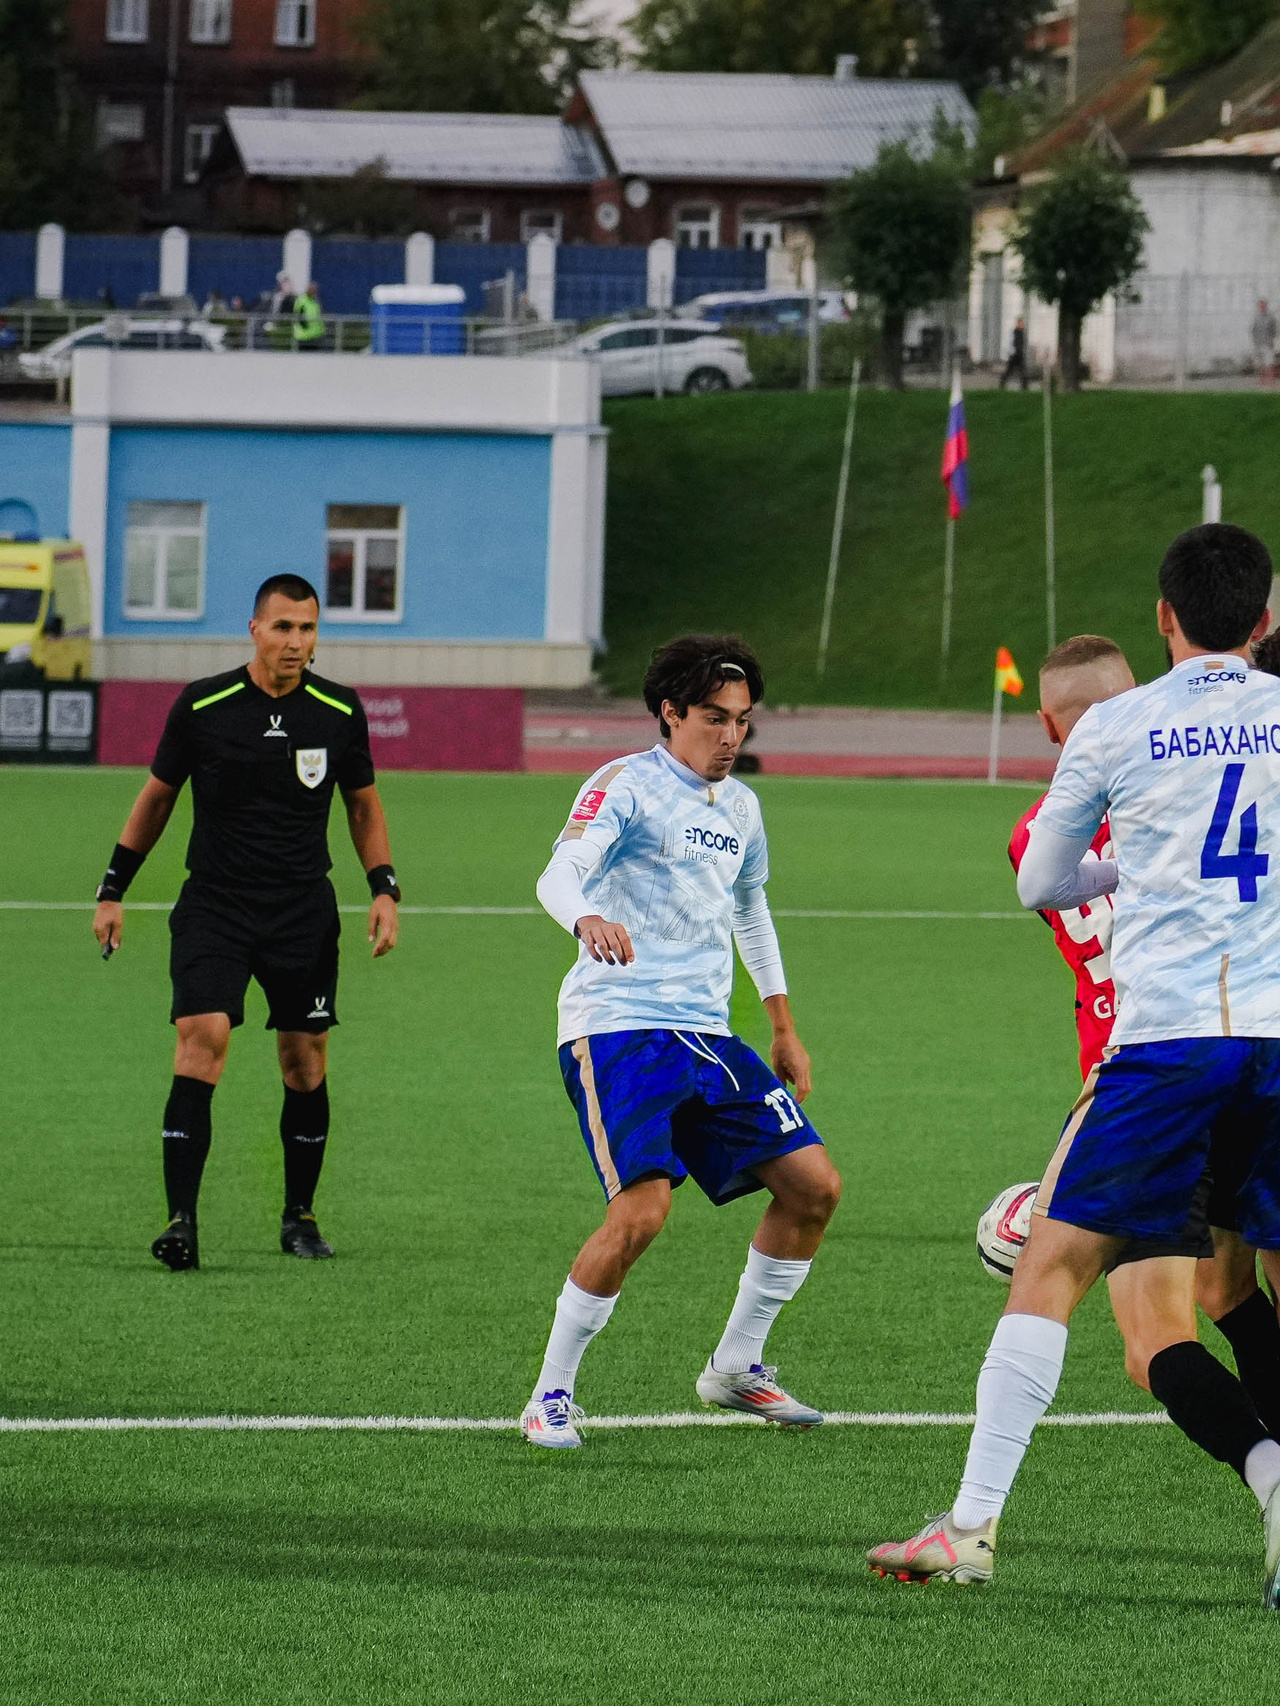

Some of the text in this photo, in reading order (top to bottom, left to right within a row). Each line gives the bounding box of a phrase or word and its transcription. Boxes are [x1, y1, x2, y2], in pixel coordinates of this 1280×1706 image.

[1187, 671, 1247, 686] encore
[1188, 684, 1224, 696] fitness
[685, 826, 739, 856] encore
[1200, 763, 1270, 903] 4
[684, 845, 719, 865] fitness
[764, 1088, 804, 1134] 17
